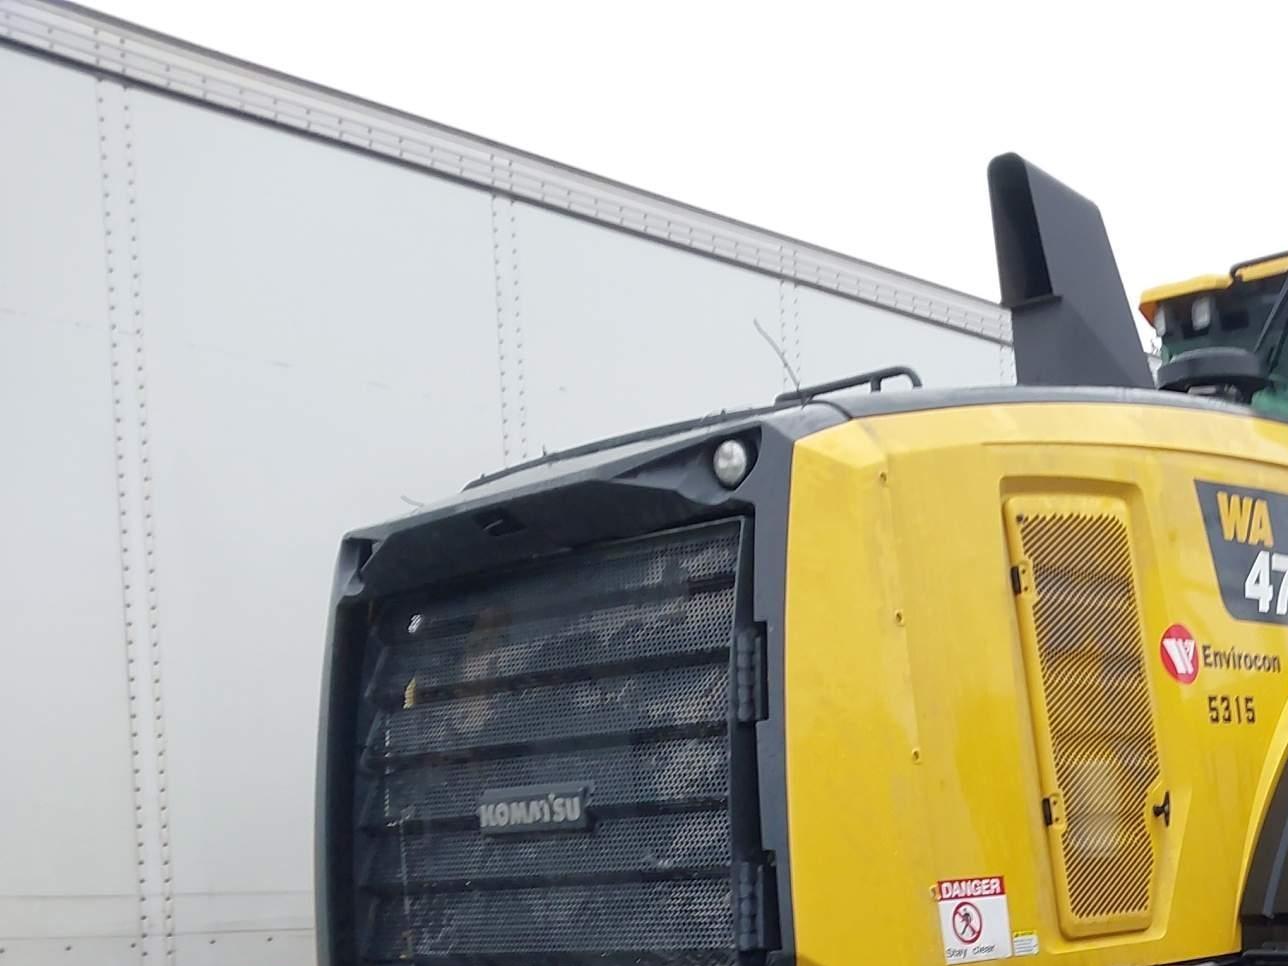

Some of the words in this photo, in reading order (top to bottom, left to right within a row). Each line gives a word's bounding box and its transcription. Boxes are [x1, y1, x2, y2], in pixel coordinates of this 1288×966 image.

[1217, 491, 1274, 547] WA
[1202, 645, 1281, 673] Envirocon
[1208, 695, 1256, 724] 5315
[480, 792, 580, 827] KOMATSU
[941, 878, 1001, 899] DANGER
